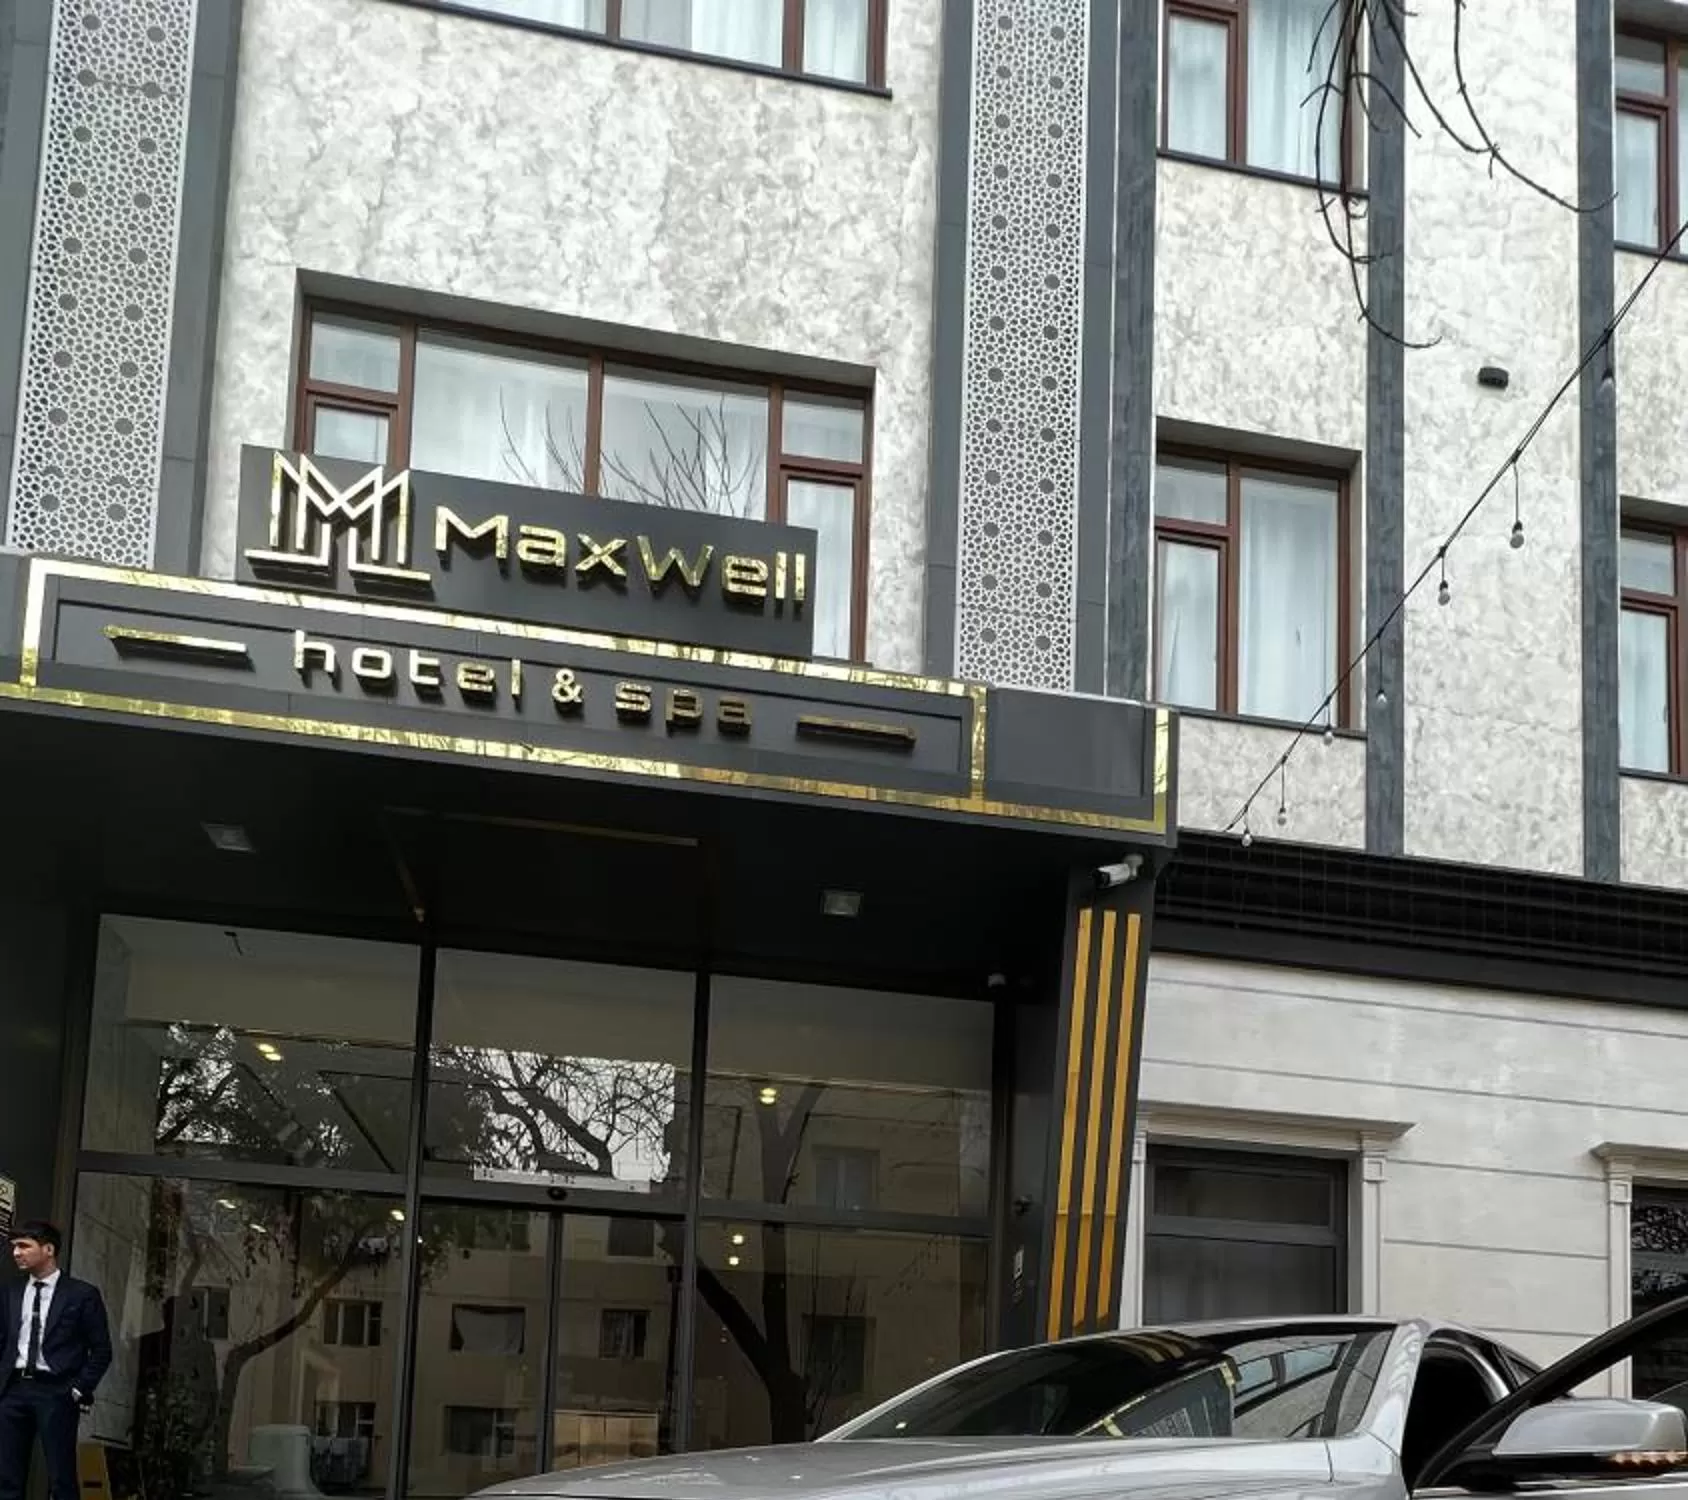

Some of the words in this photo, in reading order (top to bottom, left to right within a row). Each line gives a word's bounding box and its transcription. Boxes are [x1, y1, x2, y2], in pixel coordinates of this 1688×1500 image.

[294, 630, 522, 696] hotel
[552, 667, 583, 704] &
[615, 680, 752, 730] spa
